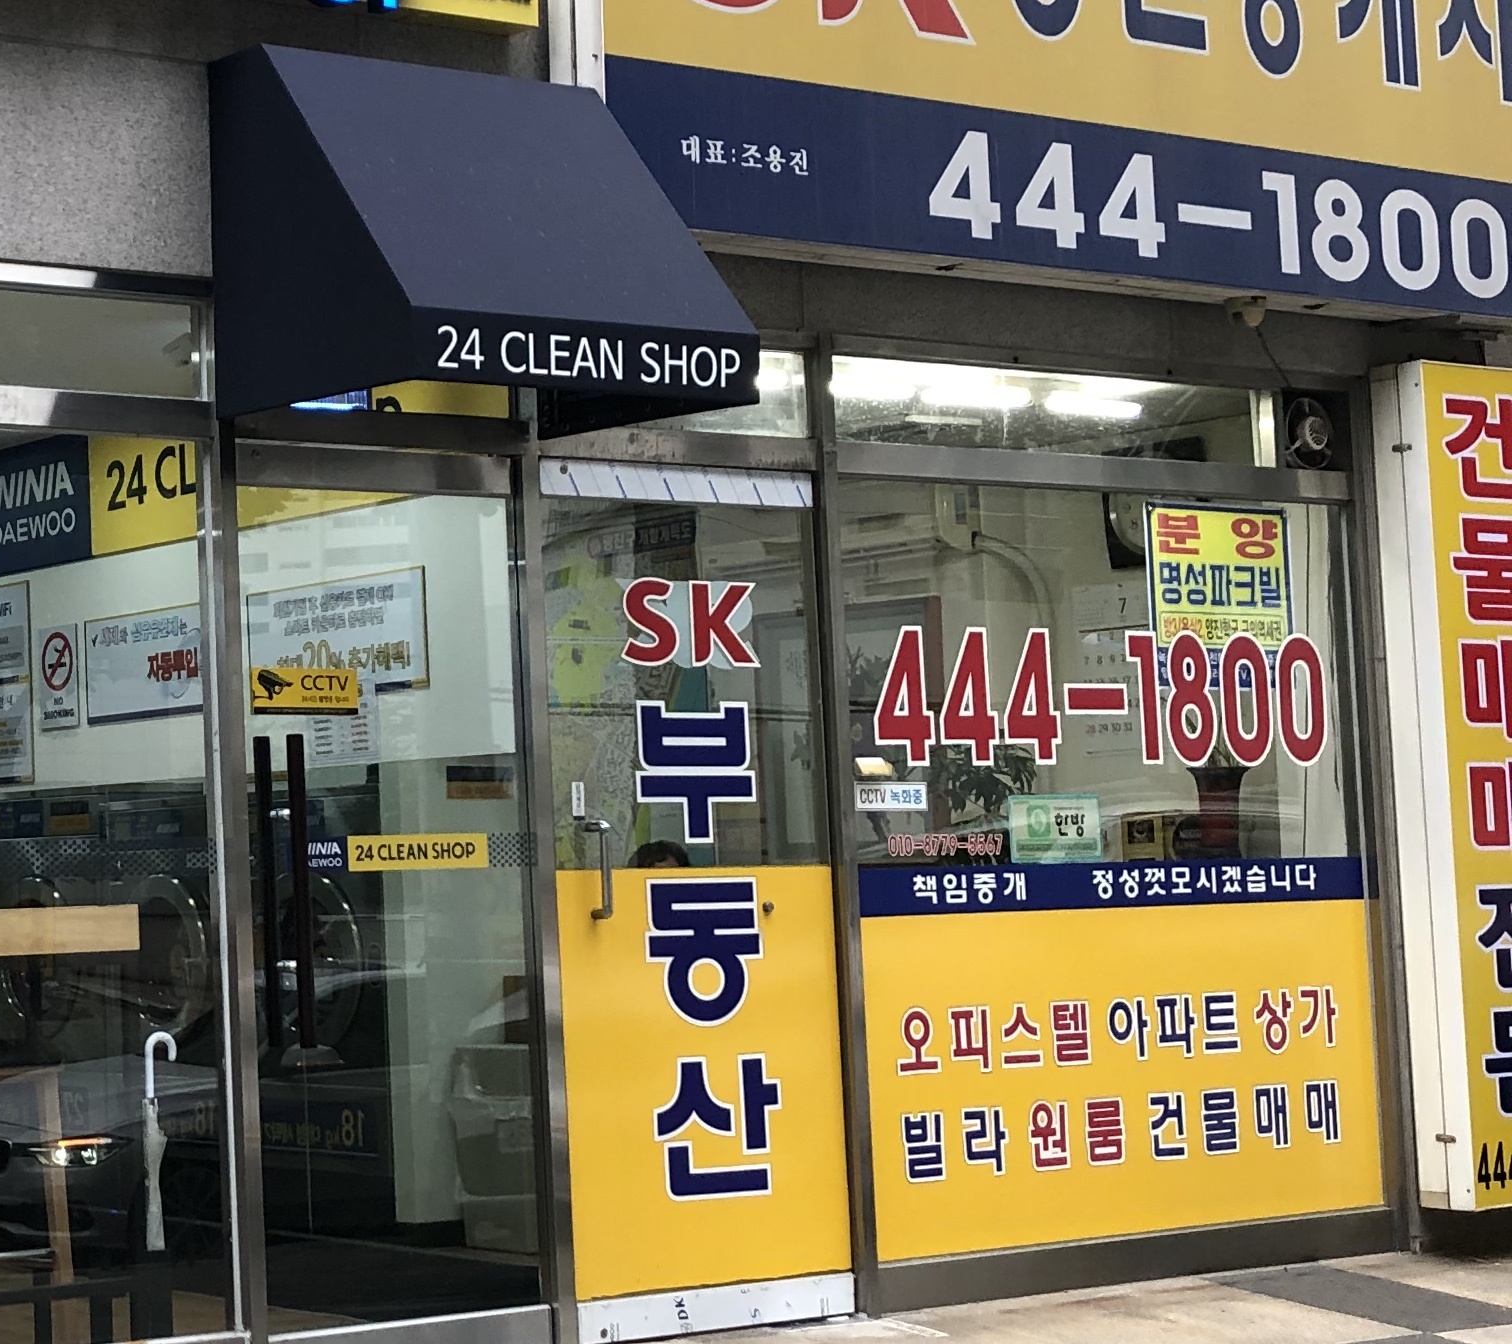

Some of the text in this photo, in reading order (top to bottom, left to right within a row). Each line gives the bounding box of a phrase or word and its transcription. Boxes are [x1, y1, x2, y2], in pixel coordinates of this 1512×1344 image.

[680, 130, 1512, 300] 대표:조용진 444-1800
[437, 325, 741, 389] 24 CLEAN SHOP
[106, 454, 147, 511] 24
[1119, 597, 1127, 614] 7
[1159, 562, 1281, 608] 명성파크빌
[621, 576, 761, 667] SK
[147, 647, 199, 683] 자동투입
[301, 675, 349, 691] CCTV
[874, 625, 1328, 767] 444-1800
[860, 788, 924, 805] CCTV 녹화중
[889, 834, 1003, 857] 010-8779-5567
[1054, 812, 1086, 838] 한방
[355, 841, 476, 862] 24 CLEAN SHOP
[912, 872, 1027, 906] 책임중개
[635, 699, 782, 1203] 부동산
[897, 985, 1340, 1076] 오피스텔 아파트 상가
[901, 1105, 1008, 1183] 빌라
[1028, 1097, 1127, 1172] 원룸
